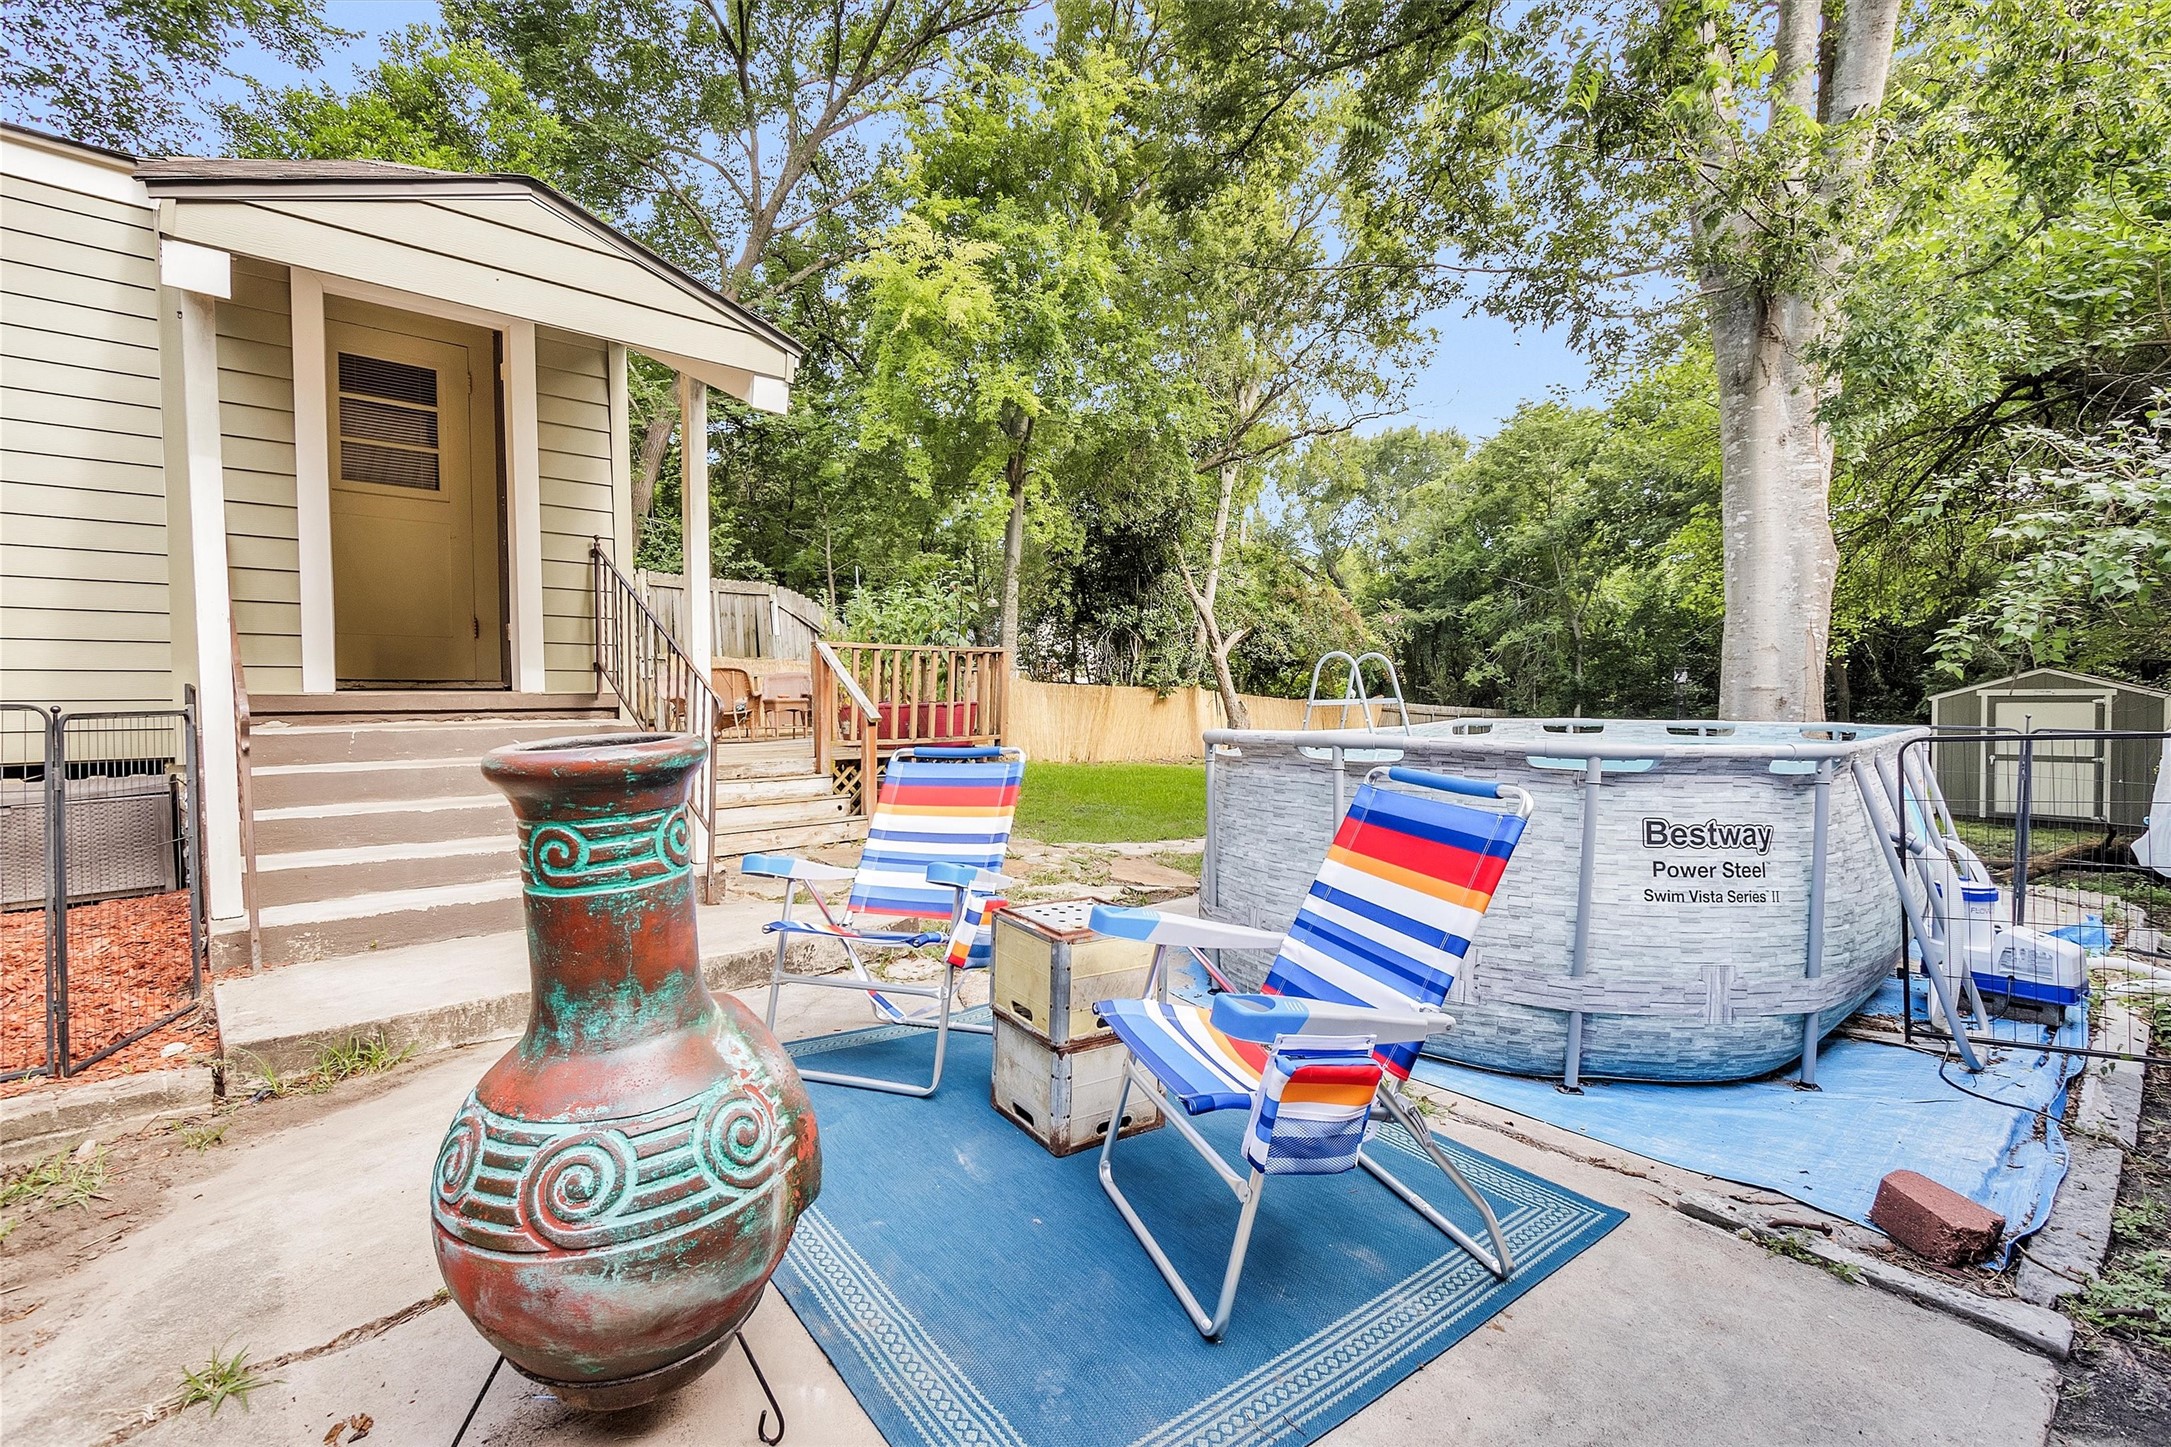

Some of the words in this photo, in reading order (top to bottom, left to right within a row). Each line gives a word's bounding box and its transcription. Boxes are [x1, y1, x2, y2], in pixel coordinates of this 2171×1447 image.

[1643, 818, 1773, 855] Bestway
[1652, 860, 1717, 878] Power
[1643, 888, 1685, 902] Swim
[1688, 889, 1724, 903] Vista
